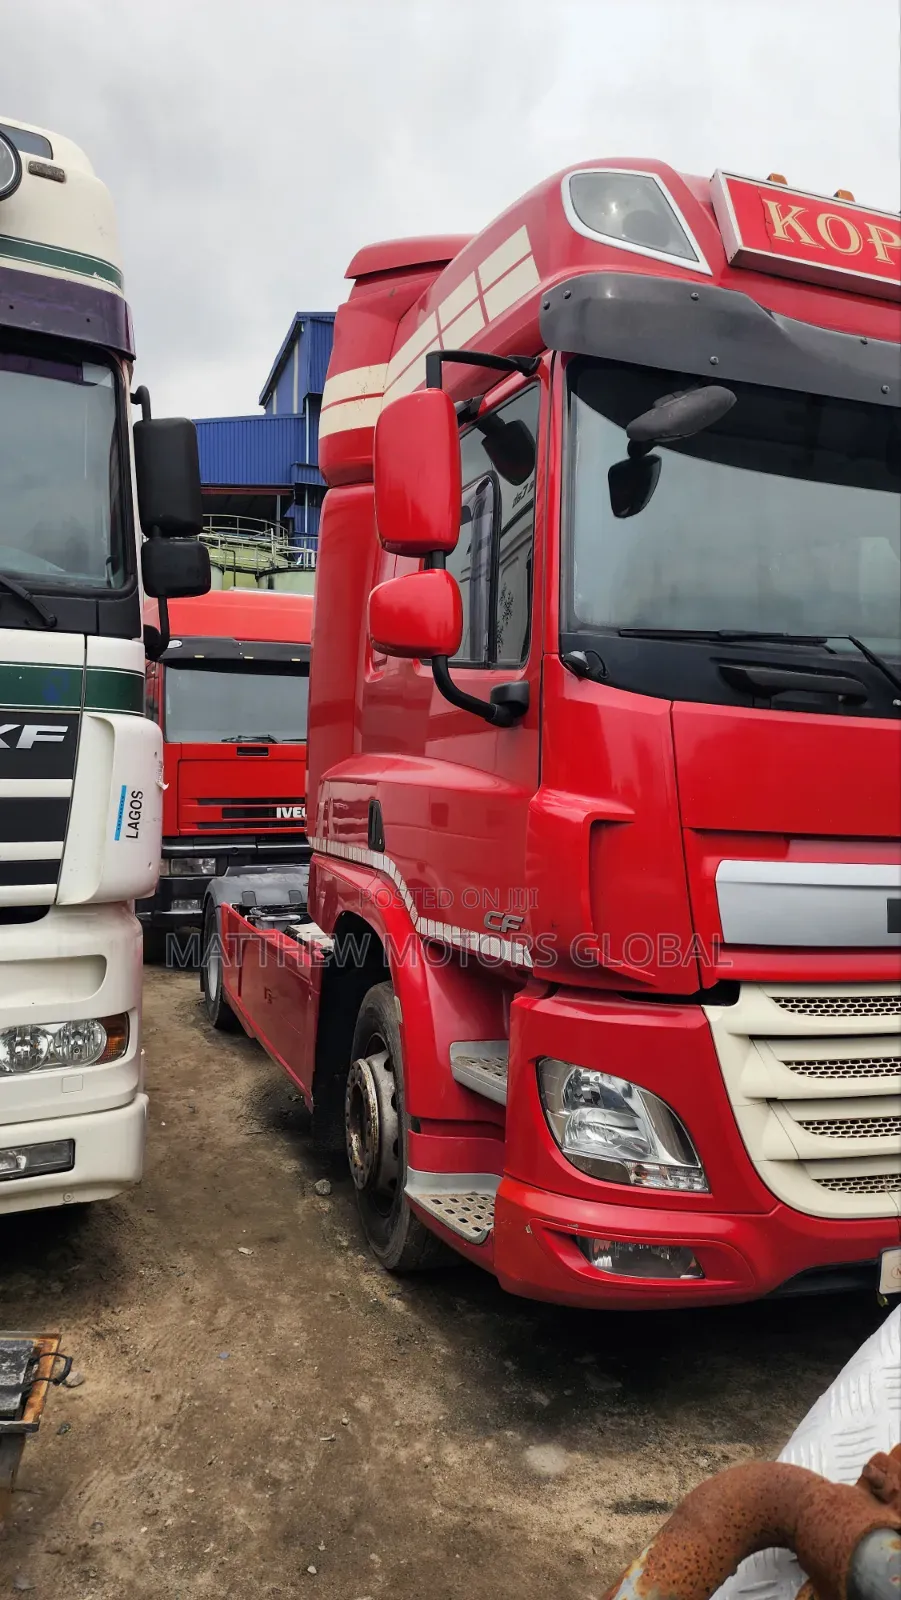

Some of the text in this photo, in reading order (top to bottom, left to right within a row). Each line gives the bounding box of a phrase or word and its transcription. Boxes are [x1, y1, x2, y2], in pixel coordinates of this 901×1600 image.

[762, 198, 901, 265] KOP
[126, 790, 144, 839] LAGOS
[483, 910, 524, 933] CF
